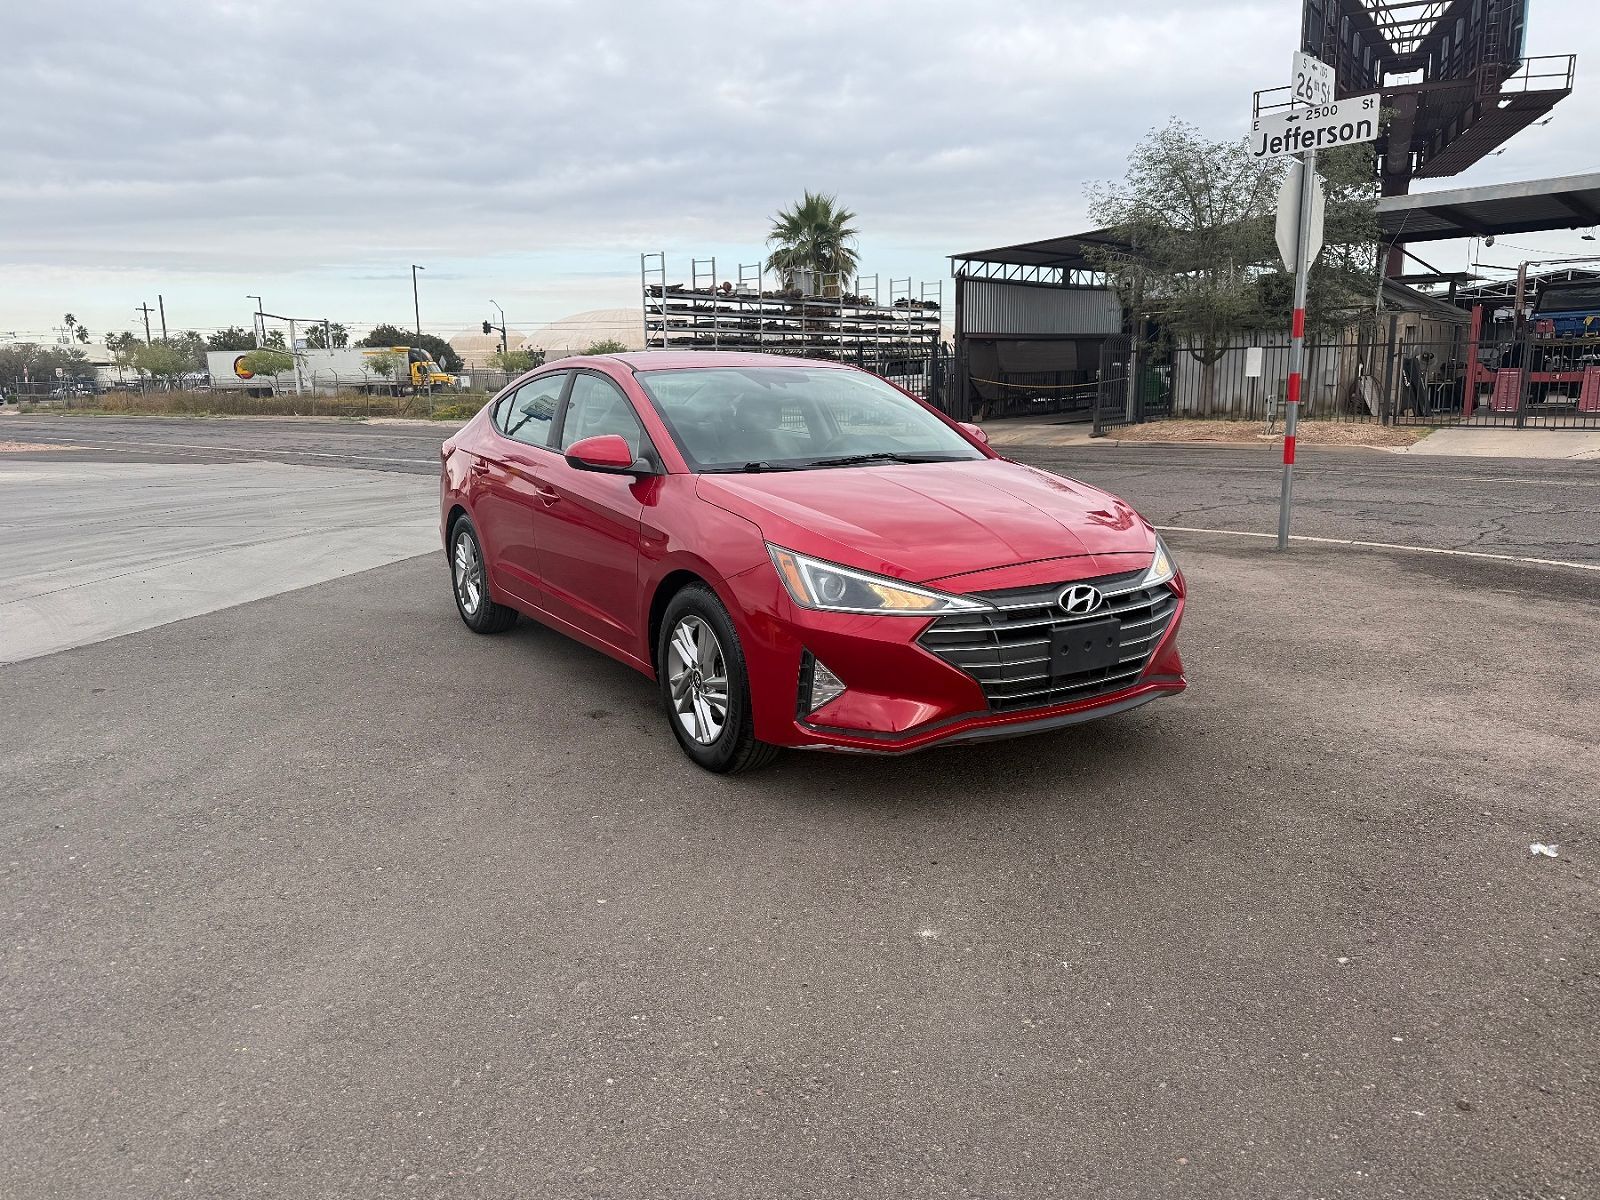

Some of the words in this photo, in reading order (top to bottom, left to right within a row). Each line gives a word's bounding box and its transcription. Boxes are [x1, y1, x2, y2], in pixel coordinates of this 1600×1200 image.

[1302, 58, 1307, 69] S
[1321, 82, 1331, 103] St
[1253, 121, 1260, 131] E
[1305, 104, 1338, 121] 2500
[1362, 98, 1374, 110] St
[1253, 119, 1372, 157] Jefferson
